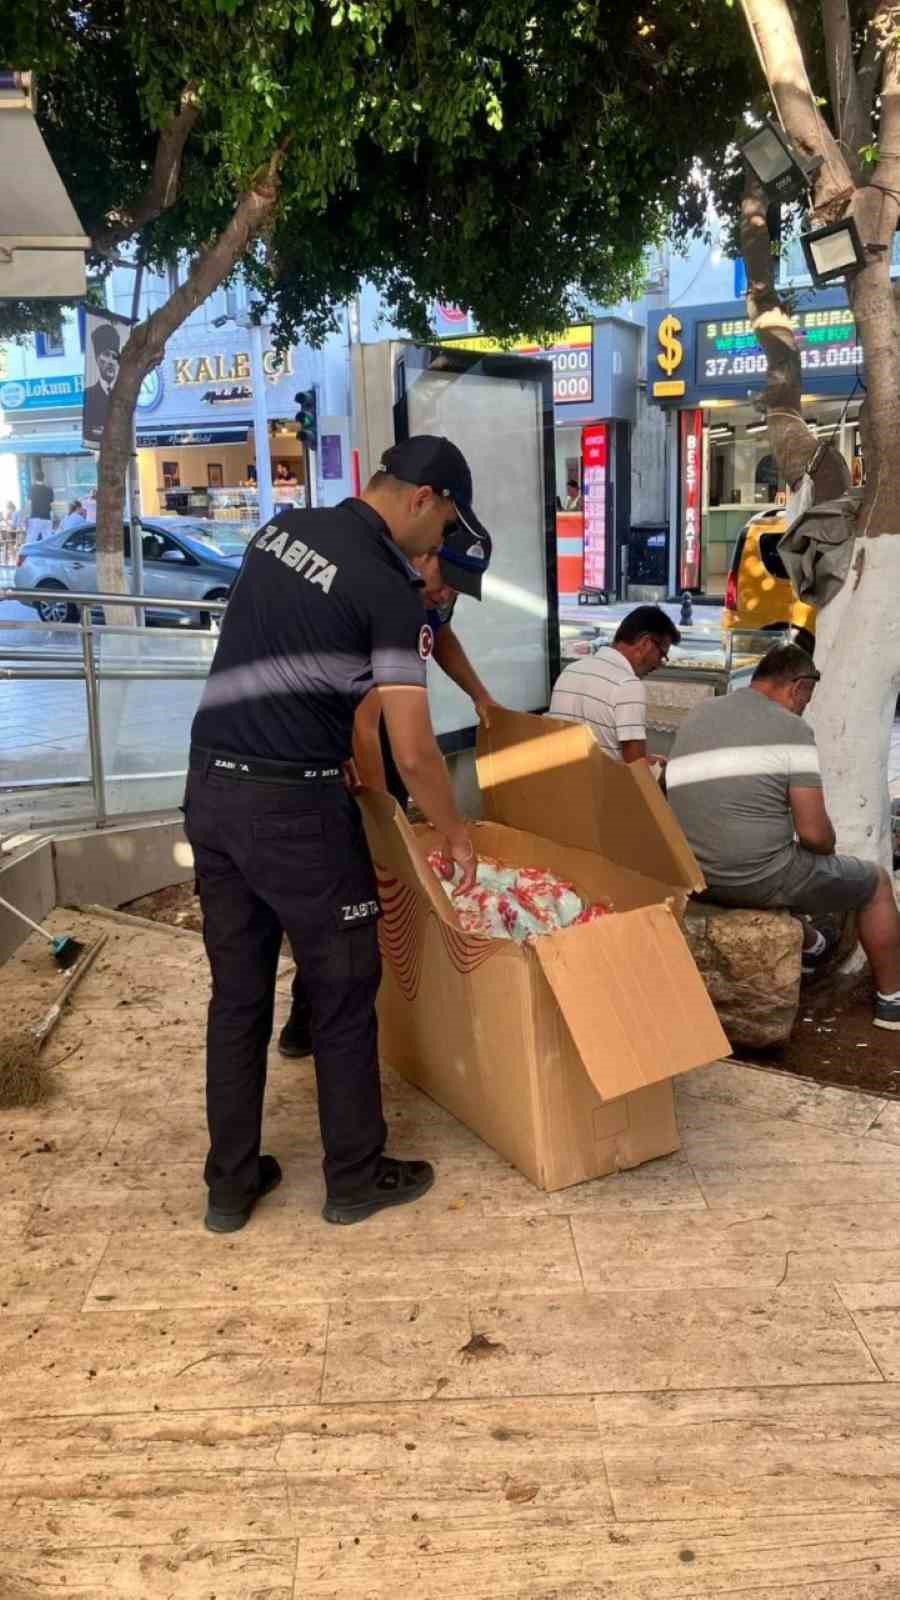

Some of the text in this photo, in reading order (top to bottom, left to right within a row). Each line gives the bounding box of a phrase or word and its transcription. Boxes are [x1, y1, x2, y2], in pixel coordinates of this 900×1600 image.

[805, 309, 855, 327] EURO
[705, 355, 769, 376] 37.000
[25, 379, 71, 397] Lokum
[685, 434, 697, 564] BEST RATE
[255, 524, 339, 594] ZABITA
